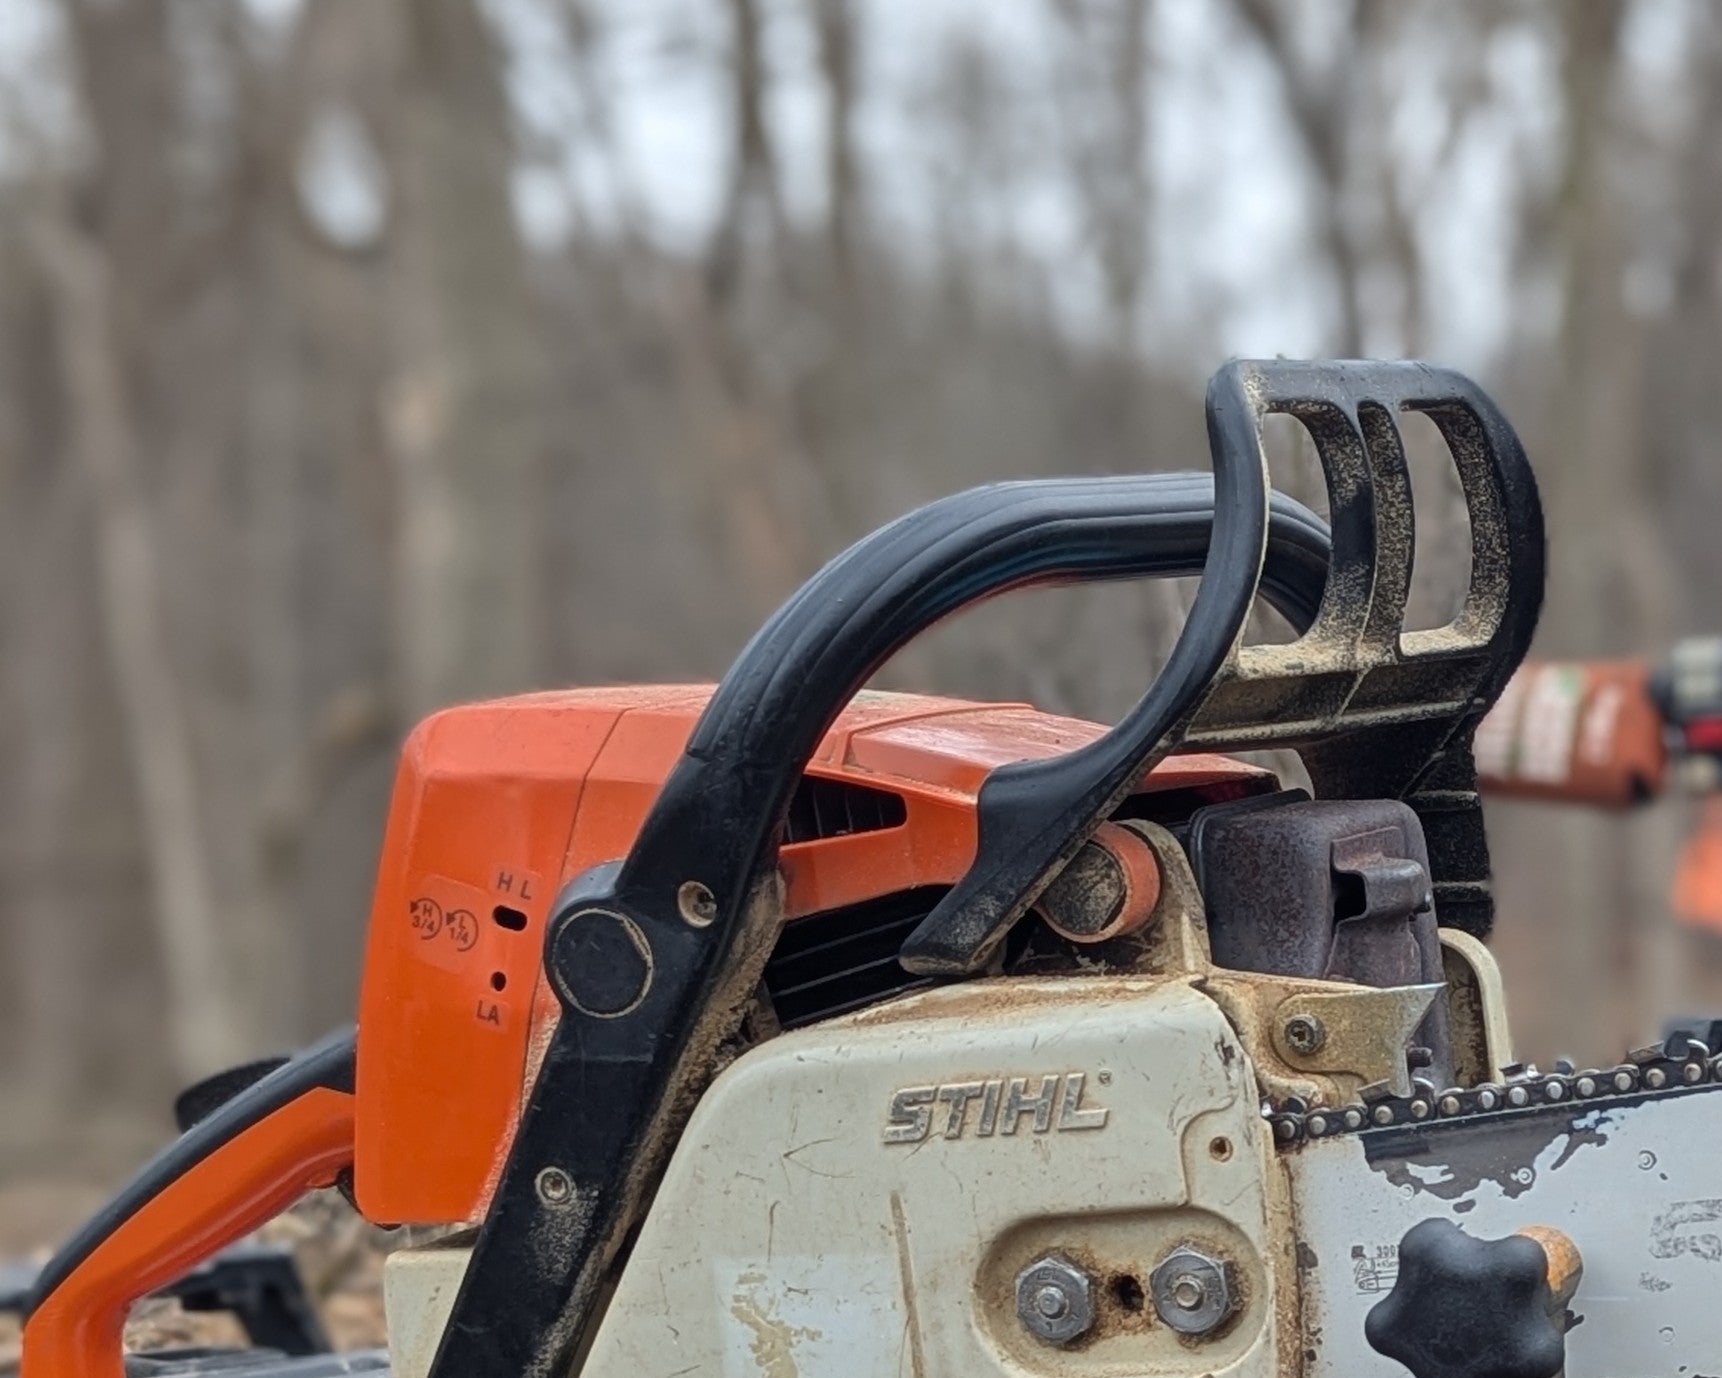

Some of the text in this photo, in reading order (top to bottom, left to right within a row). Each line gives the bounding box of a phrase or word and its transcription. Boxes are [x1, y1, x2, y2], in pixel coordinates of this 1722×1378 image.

[497, 871, 532, 900] H L
[476, 999, 500, 1027] LA
[884, 1072, 1110, 1146] STIHL
